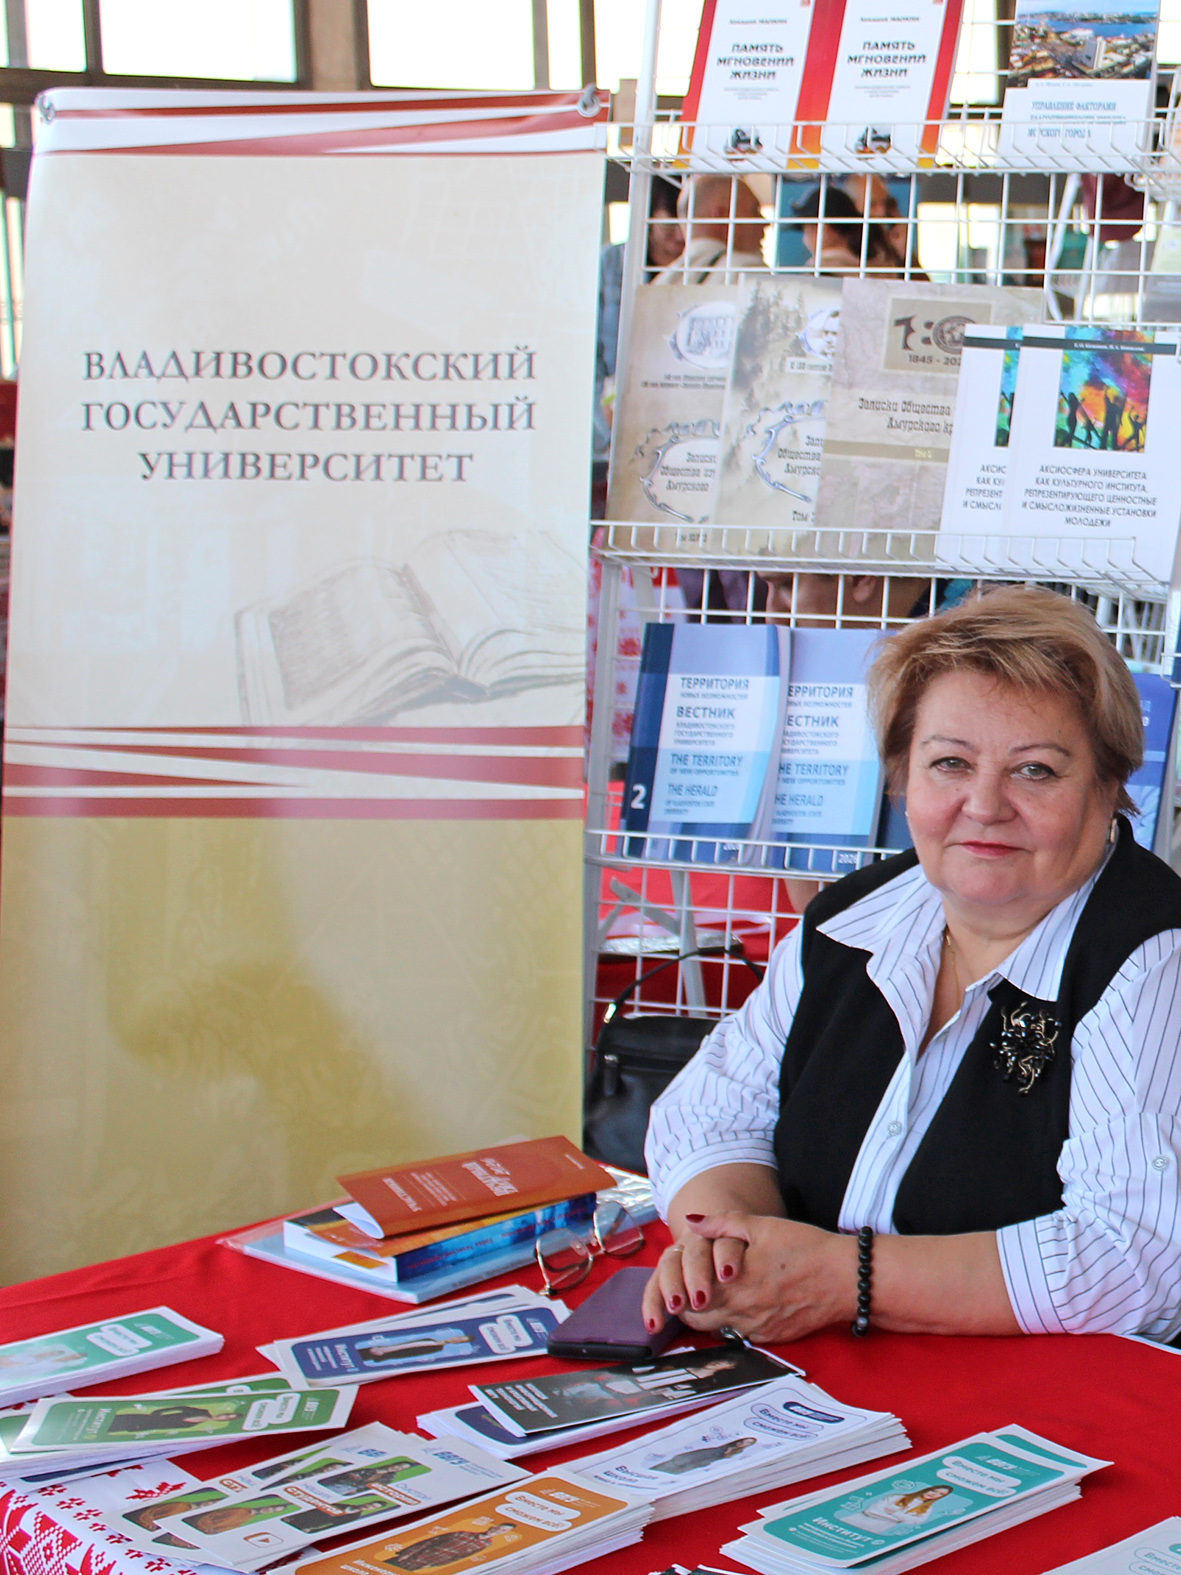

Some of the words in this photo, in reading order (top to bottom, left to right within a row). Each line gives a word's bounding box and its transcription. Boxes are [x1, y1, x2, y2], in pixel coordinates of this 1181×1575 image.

[732, 43, 784, 53] ПАМЯТЬ
[863, 41, 915, 51] ПАМЯТЬ
[730, 69, 776, 80] ЖИЗНИ
[861, 68, 908, 78] ЖИЗНИ
[83, 346, 536, 382] ВЛАДИВОСТОКСКИЙ
[909, 354, 933, 364] 1845
[81, 397, 536, 432] ГОСУДАРСТВЕННЫЙ
[901, 400, 951, 416] Общества
[887, 417, 941, 433] Амурского
[139, 452, 473, 483] УНИВЕРСИТЕТ
[1040, 465, 1091, 477] АКСИОСФЕРА
[1093, 469, 1147, 480] УНИВЕРСИТЕТА
[1035, 477, 1051, 486] КАК
[1053, 478, 1103, 490] КУЛЬТУРНОГО
[1024, 488, 1105, 502] РЕПРЕЗЕНТИРУЮЩЕГО
[1106, 494, 1157, 506] ЦЕННОСТНЫЕ
[1029, 502, 1110, 515] СМЫСЛОЖИЗНЕННЫЕ
[1112, 507, 1157, 518] УСТАНОВКИ
[1065, 516, 1111, 528] МОЛОДЕЖИ
[680, 677, 749, 690] ТЕРРИТОРИЯ
[676, 706, 735, 719] ВЕСТНИК
[671, 753, 689, 765] THE
[692, 754, 744, 767] TERRITORY
[795, 764, 849, 777] TERRITORY
[630, 785, 647, 809] 2
[668, 784, 683, 796] THE
[685, 785, 718, 797] HERALD
[788, 794, 824, 806] HERALD
[759, 1408, 792, 1426] Вместе
[951, 1460, 987, 1481] Вместе
[515, 1495, 549, 1512] Вместе
[812, 1516, 873, 1543] Институт
